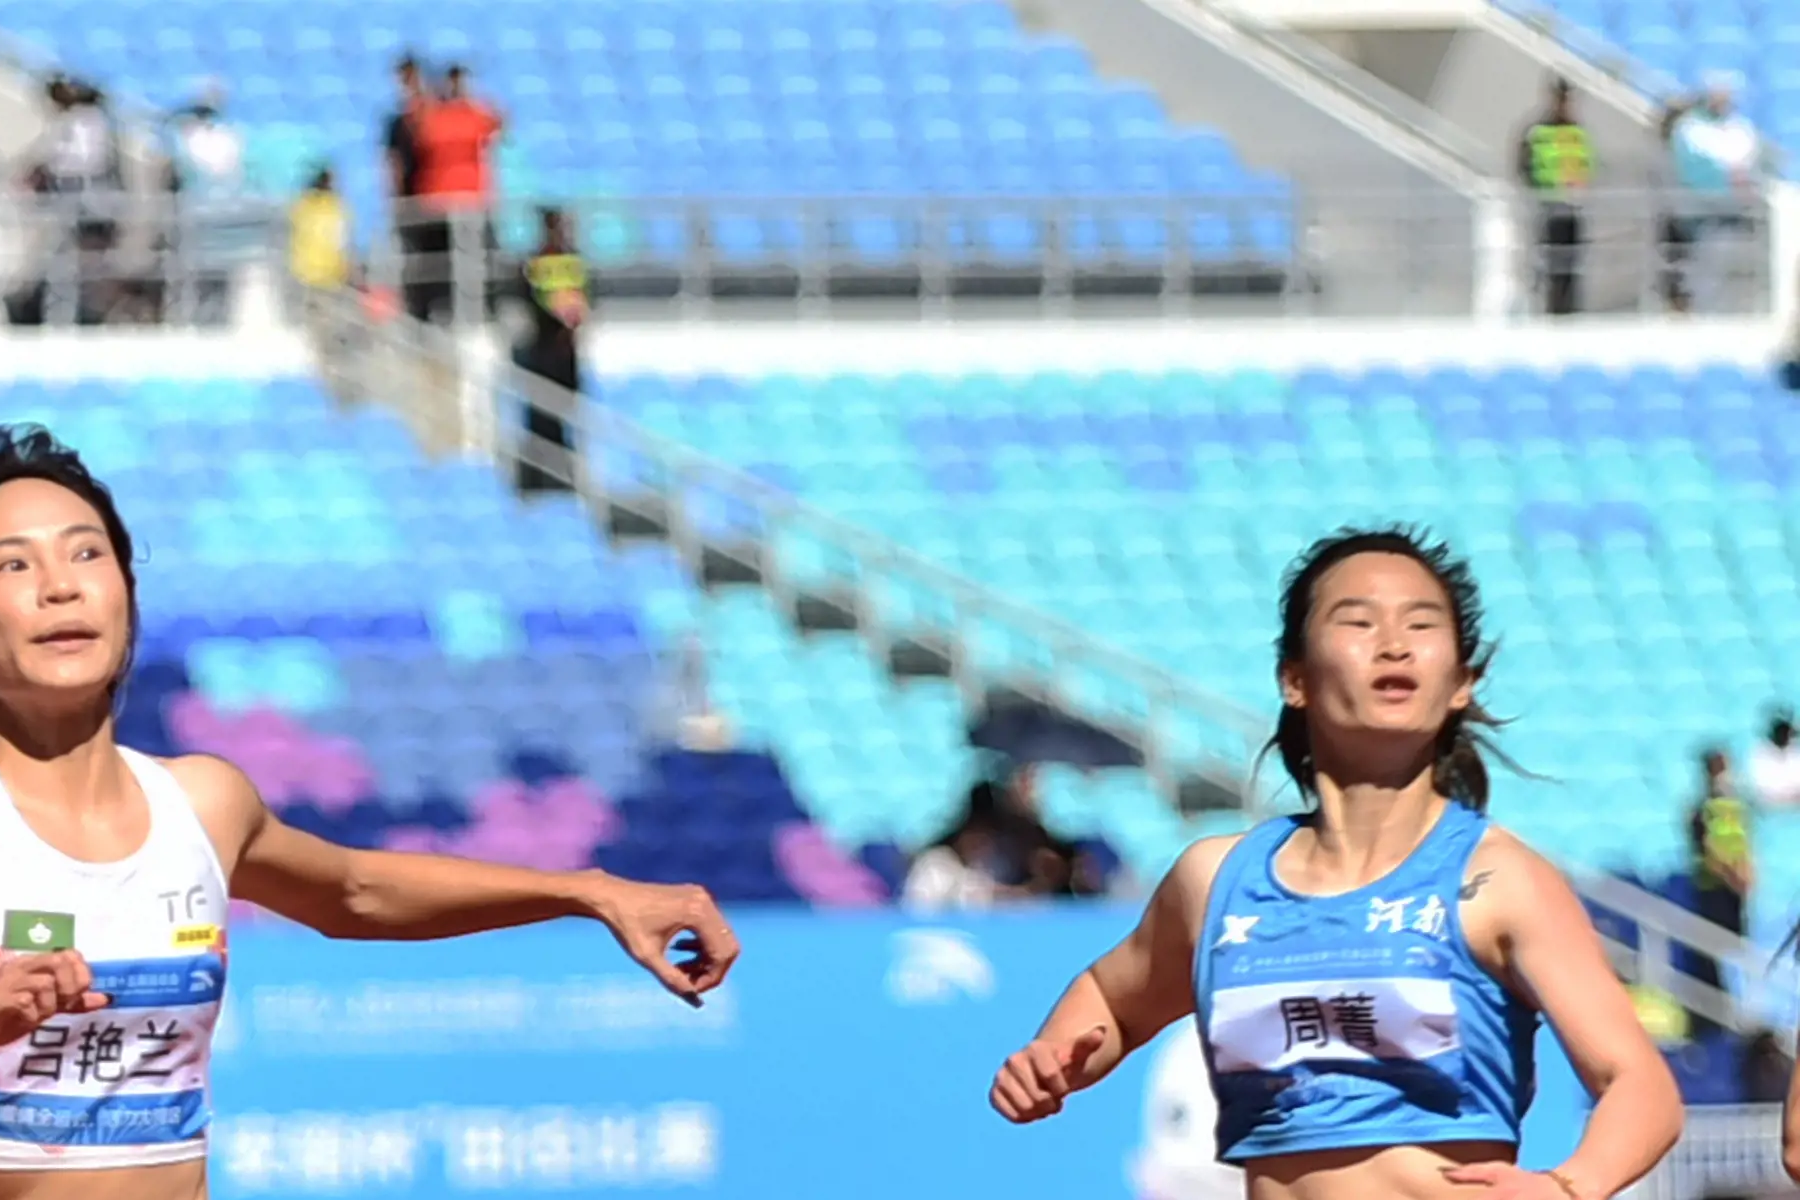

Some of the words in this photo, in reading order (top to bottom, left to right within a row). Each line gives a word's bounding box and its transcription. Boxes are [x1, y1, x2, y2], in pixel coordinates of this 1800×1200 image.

[1365, 894, 1448, 940] 河南
[16, 1020, 180, 1083] 吕艳兰
[1280, 992, 1379, 1052] 周菁
